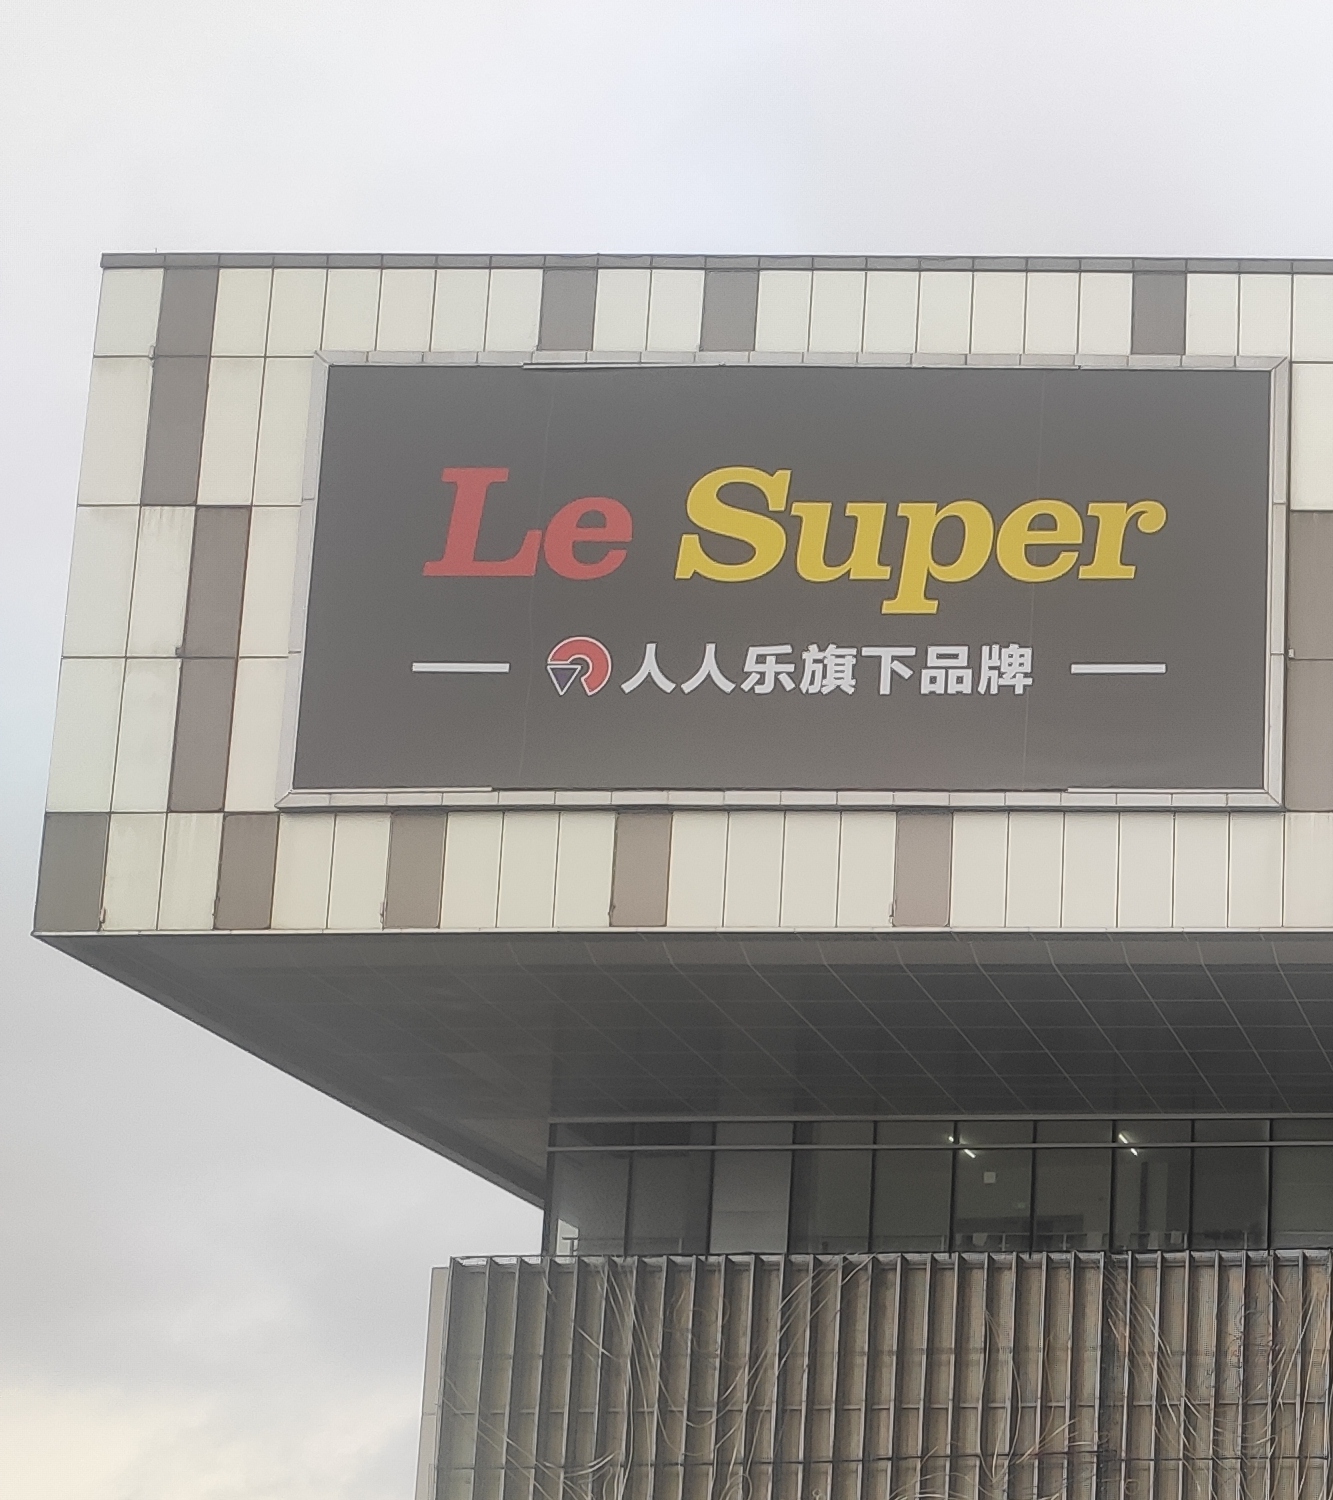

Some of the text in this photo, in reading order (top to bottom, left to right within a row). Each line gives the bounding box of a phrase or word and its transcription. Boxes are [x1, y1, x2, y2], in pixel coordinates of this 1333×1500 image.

[422, 465, 1169, 614] Le Super
[619, 643, 1035, 698] 人人乐旗下品牌
